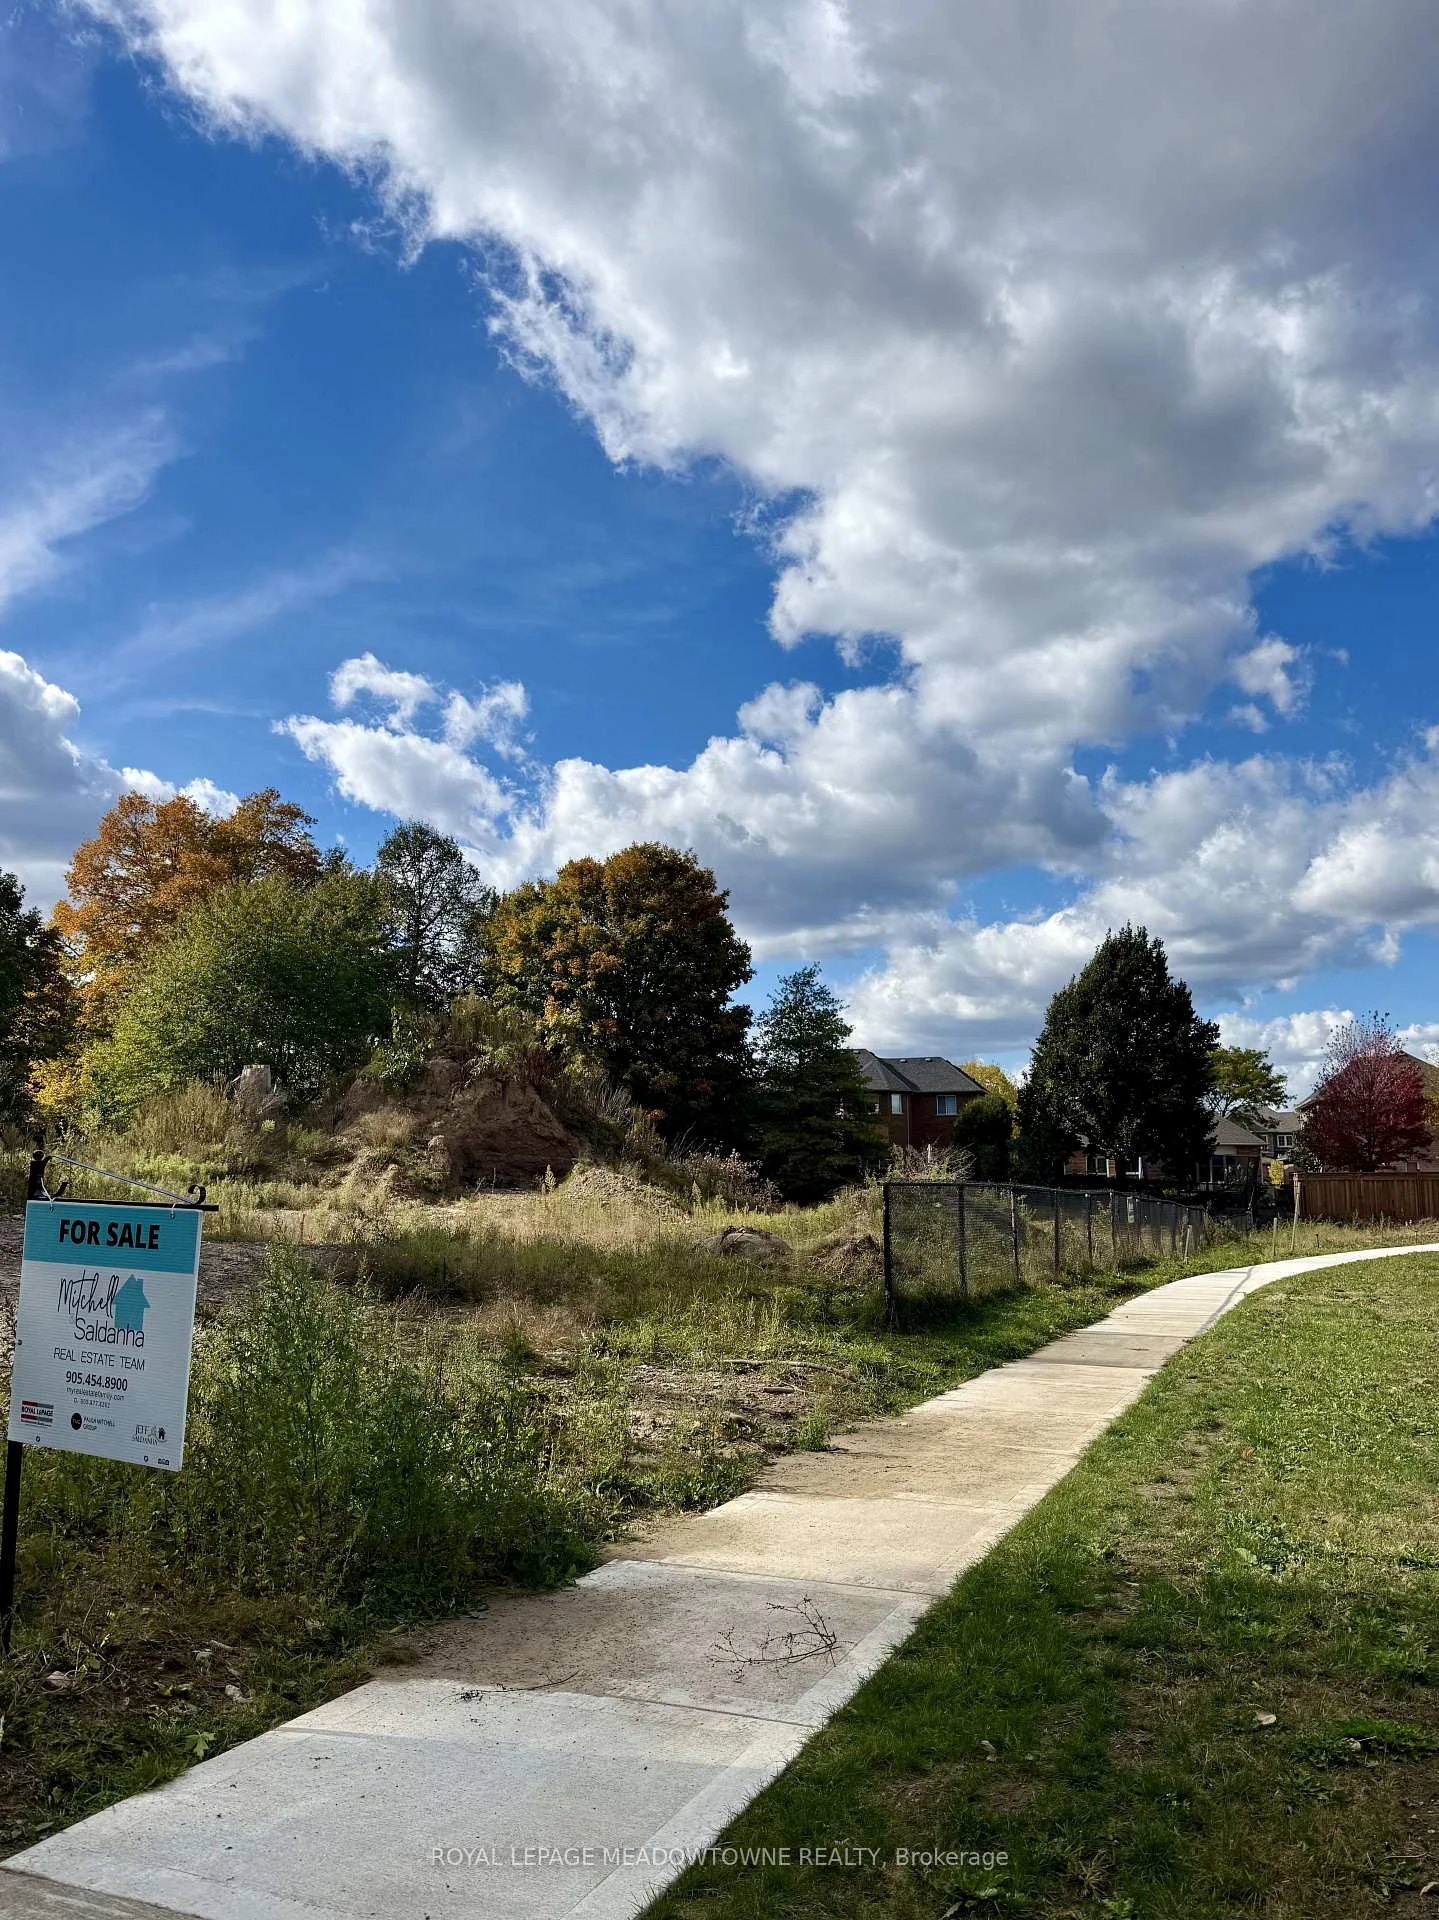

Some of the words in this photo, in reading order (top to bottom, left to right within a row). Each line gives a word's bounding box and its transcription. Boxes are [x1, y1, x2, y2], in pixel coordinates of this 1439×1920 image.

[59, 1219, 100, 1245] FOR
[106, 1222, 160, 1249] SALE
[57, 1270, 119, 1319] Mitchell
[54, 1347, 76, 1362] REAL
[81, 1351, 116, 1367] ESTATE
[120, 1356, 145, 1371] TEAM
[66, 1371, 128, 1391] 905.454.8900
[22, 1406, 36, 1414] ROYAL
